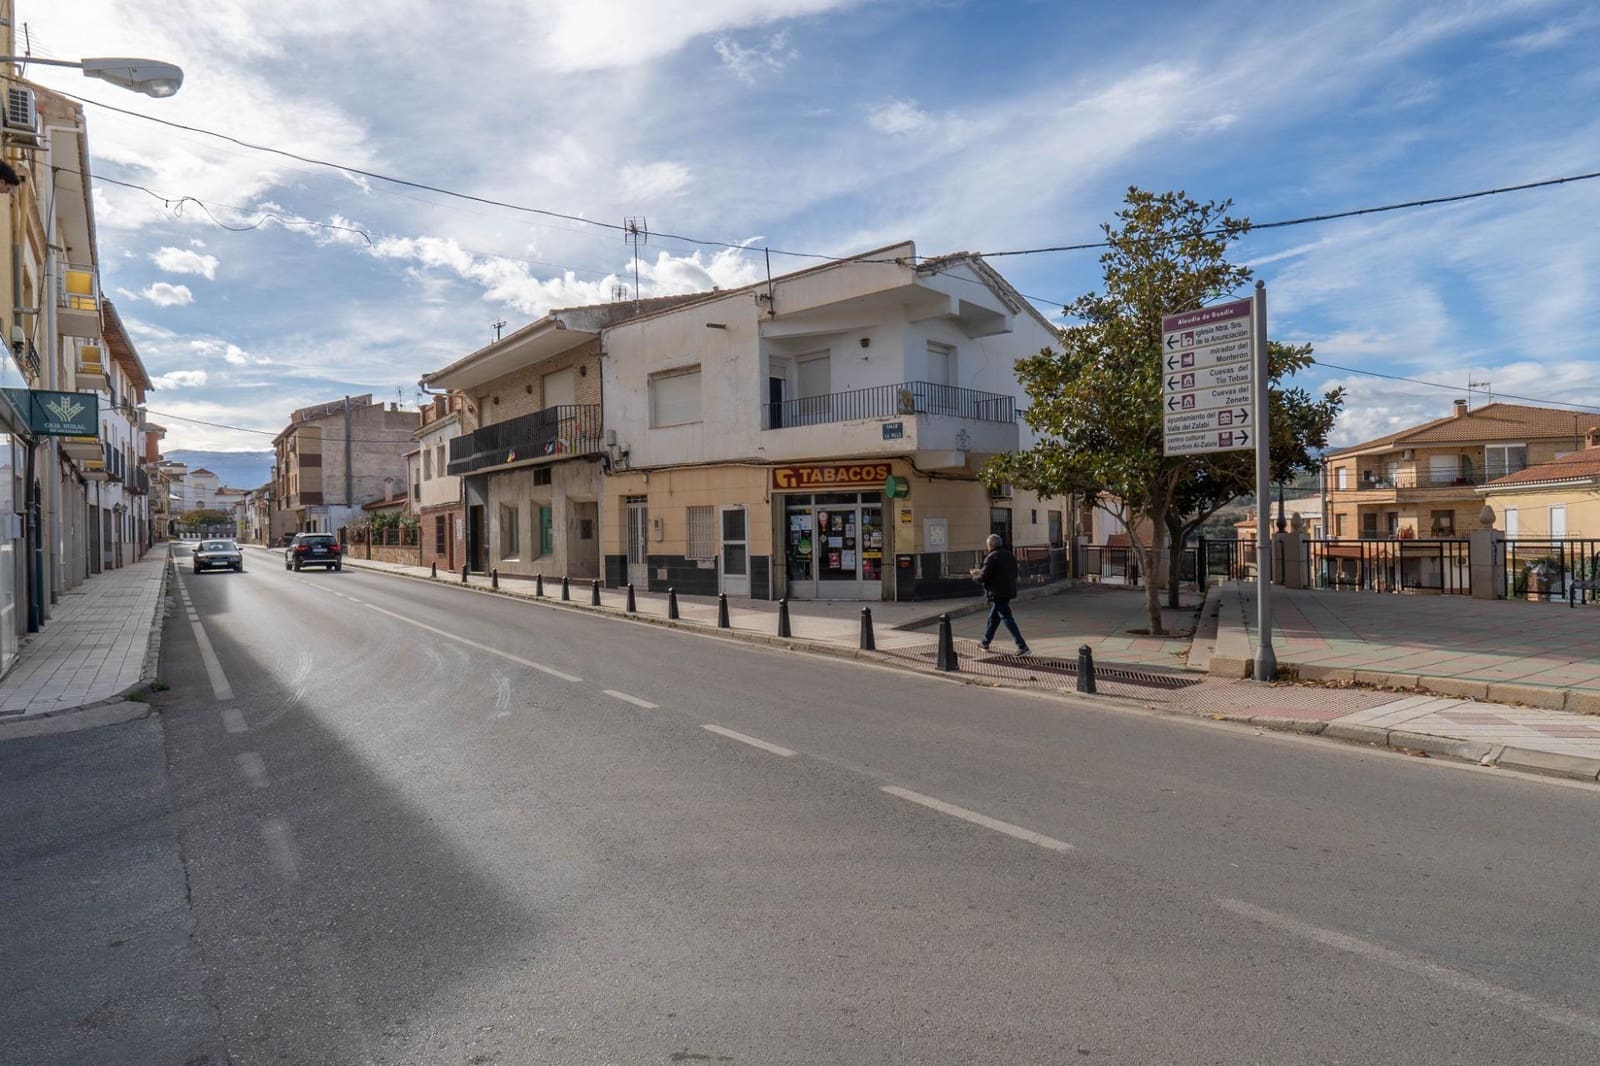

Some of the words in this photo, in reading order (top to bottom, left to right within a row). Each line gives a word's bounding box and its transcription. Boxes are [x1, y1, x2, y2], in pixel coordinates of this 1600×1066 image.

[1210, 330, 1249, 342] Anunciación
[1210, 345, 1236, 354] mirador
[1237, 341, 1249, 350] del
[1209, 367, 1234, 376] Cuevas
[1237, 363, 1249, 372] del
[1227, 374, 1249, 383] Tobas
[1211, 388, 1237, 397] Cuevas
[1238, 385, 1249, 394] del
[1225, 396, 1249, 405] Zenete
[1167, 412, 1206, 424] ayuntamiento
[1206, 411, 1216, 419] del
[1184, 434, 1206, 442] cultural
[1167, 443, 1193, 451] deportivo
[799, 466, 888, 483] TABACOS
